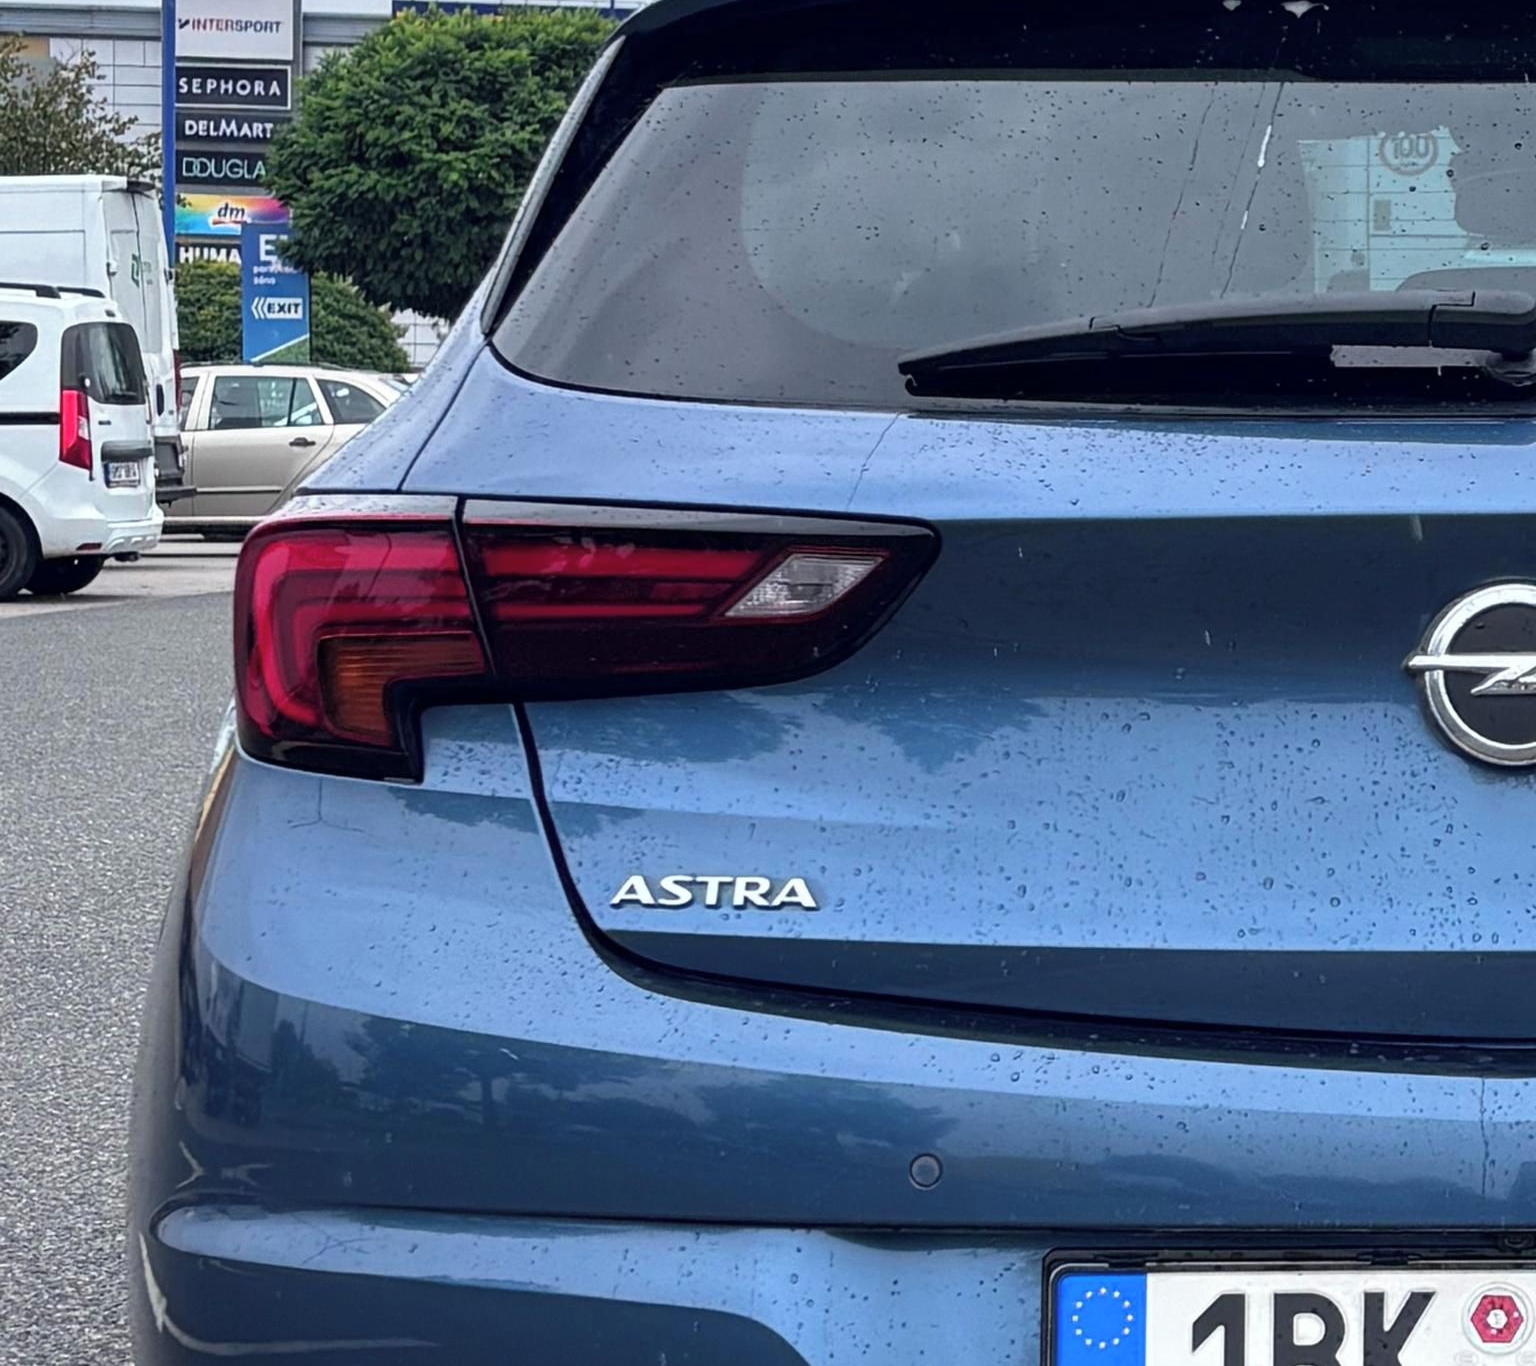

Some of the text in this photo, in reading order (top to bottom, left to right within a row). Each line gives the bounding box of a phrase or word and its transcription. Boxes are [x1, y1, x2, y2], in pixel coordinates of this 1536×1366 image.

[191, 18, 281, 33] INTERSPORT
[179, 77, 281, 96] SEPHORA
[184, 118, 274, 138] DELMART
[182, 157, 267, 179] DOUGLA
[217, 202, 245, 219] dm
[179, 246, 242, 264] HUMA
[267, 302, 301, 315] EXIT
[610, 874, 820, 910] ASTRA
